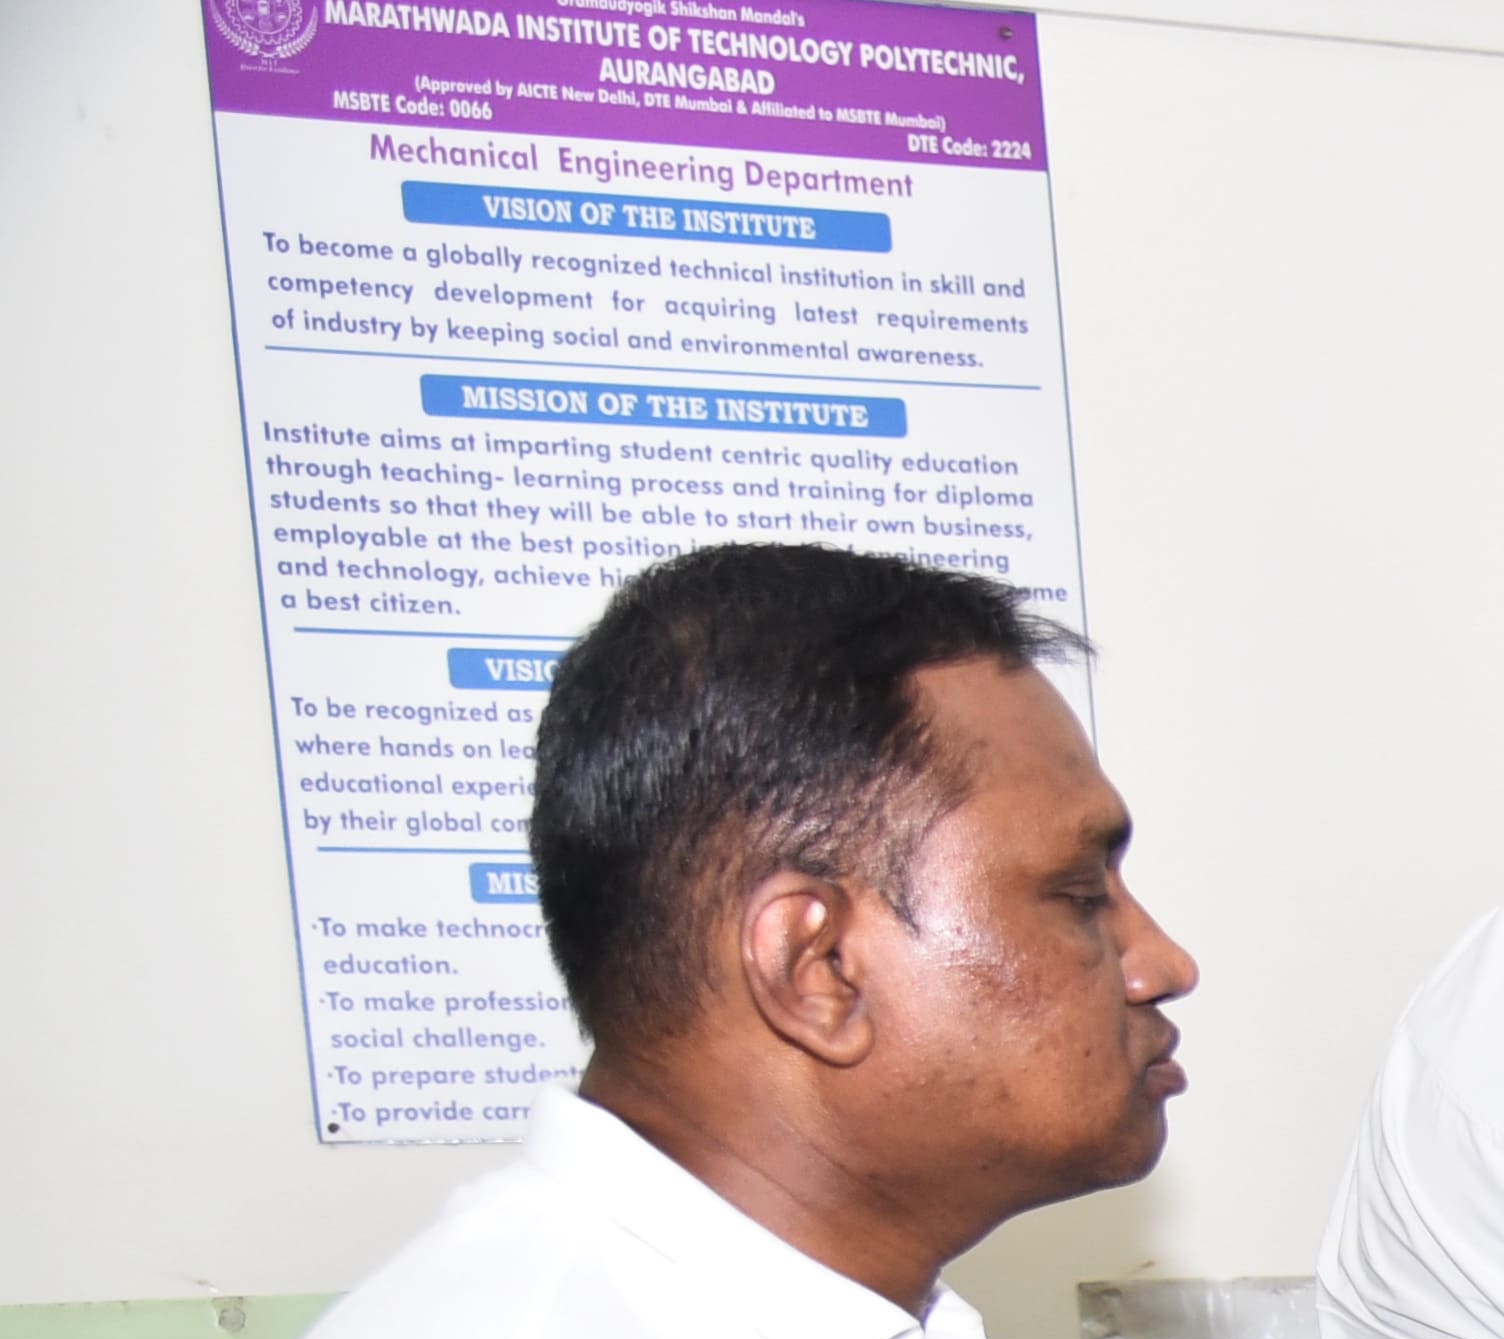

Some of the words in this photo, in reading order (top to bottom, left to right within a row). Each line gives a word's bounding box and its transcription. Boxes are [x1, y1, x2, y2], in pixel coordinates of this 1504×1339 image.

[670, 3, 737, 21] Shikshan
[324, 0, 511, 38] MARATHWADA
[516, 13, 642, 49] INSTITUTE
[647, 24, 682, 52] OF
[686, 27, 854, 67] TECHNOLOGY
[859, 42, 1025, 84] POLYTECHNIC,
[599, 57, 776, 96] AURANGABAD
[333, 89, 391, 113] MSBTE
[394, 94, 445, 117] Code:
[448, 98, 493, 121] 0066
[414, 74, 493, 96] (Approved
[494, 80, 514, 100] by
[516, 82, 559, 101] AICTE
[560, 85, 595, 103] New
[597, 88, 641, 108] Delhi,
[643, 91, 672, 109] DTE
[674, 94, 733, 114] Mumbai
[735, 99, 749, 115] &
[750, 100, 817, 121] Affiliated
[817, 107, 834, 122] to
[835, 107, 882, 126] MSBTE
[884, 111, 947, 133] Mumbai)
[369, 133, 539, 172] Mechanical
[557, 146, 735, 193] Engineering
[744, 159, 913, 198] Department
[907, 133, 939, 154] DTE
[941, 135, 988, 158] Code:
[991, 139, 1032, 160] 2224
[482, 195, 572, 223] VISION
[579, 201, 616, 227] OF
[621, 204, 677, 231] THE
[682, 208, 817, 240] INSTITUTE
[261, 230, 291, 254] To
[297, 232, 394, 261] become
[402, 246, 418, 262] a
[425, 242, 523, 274] globally
[531, 253, 662, 279] recognized
[669, 258, 772, 283] technical
[780, 264, 894, 291] institution
[901, 271, 923, 292] in
[930, 273, 976, 295] skill
[982, 277, 1026, 299] and
[266, 275, 414, 305] competency
[433, 279, 593, 312] development
[611, 289, 645, 312] for
[664, 296, 777, 326] acquiring
[794, 301, 858, 325] latest
[876, 309, 1029, 335] requirements
[271, 307, 295, 330] of
[302, 309, 403, 342] industry
[410, 315, 439, 344] by
[446, 317, 545, 350] keeping
[552, 326, 619, 348] social
[627, 329, 673, 351] and
[680, 334, 849, 361] environmental
[856, 347, 984, 368] awareness.
[461, 385, 588, 414] MISSION
[597, 392, 639, 417] OF
[645, 394, 709, 421] THE
[715, 397, 869, 429] INSTITUTE
[262, 420, 371, 448] Institute
[379, 427, 443, 451] aims
[450, 433, 476, 452] at
[484, 431, 612, 464] imparting
[620, 440, 713, 462] student
[721, 446, 801, 467] centric
[810, 449, 893, 476] quality
[901, 451, 1019, 475] education
[273, 522, 428, 552] employable
[436, 531, 463, 550] at
[470, 529, 512, 552] the
[520, 531, 573, 554] best
[582, 536, 684, 565] position
[276, 555, 329, 578] and
[336, 557, 485, 589] technology,
[493, 564, 591, 587] achieve
[289, 695, 319, 718] To
[325, 695, 357, 719] be
[364, 700, 499, 726] recognized
[506, 707, 534, 723] as
[299, 770, 443, 795] educational
[322, 952, 458, 975] education.
[330, 1026, 404, 1049] social
[412, 1026, 545, 1054] challenge.
